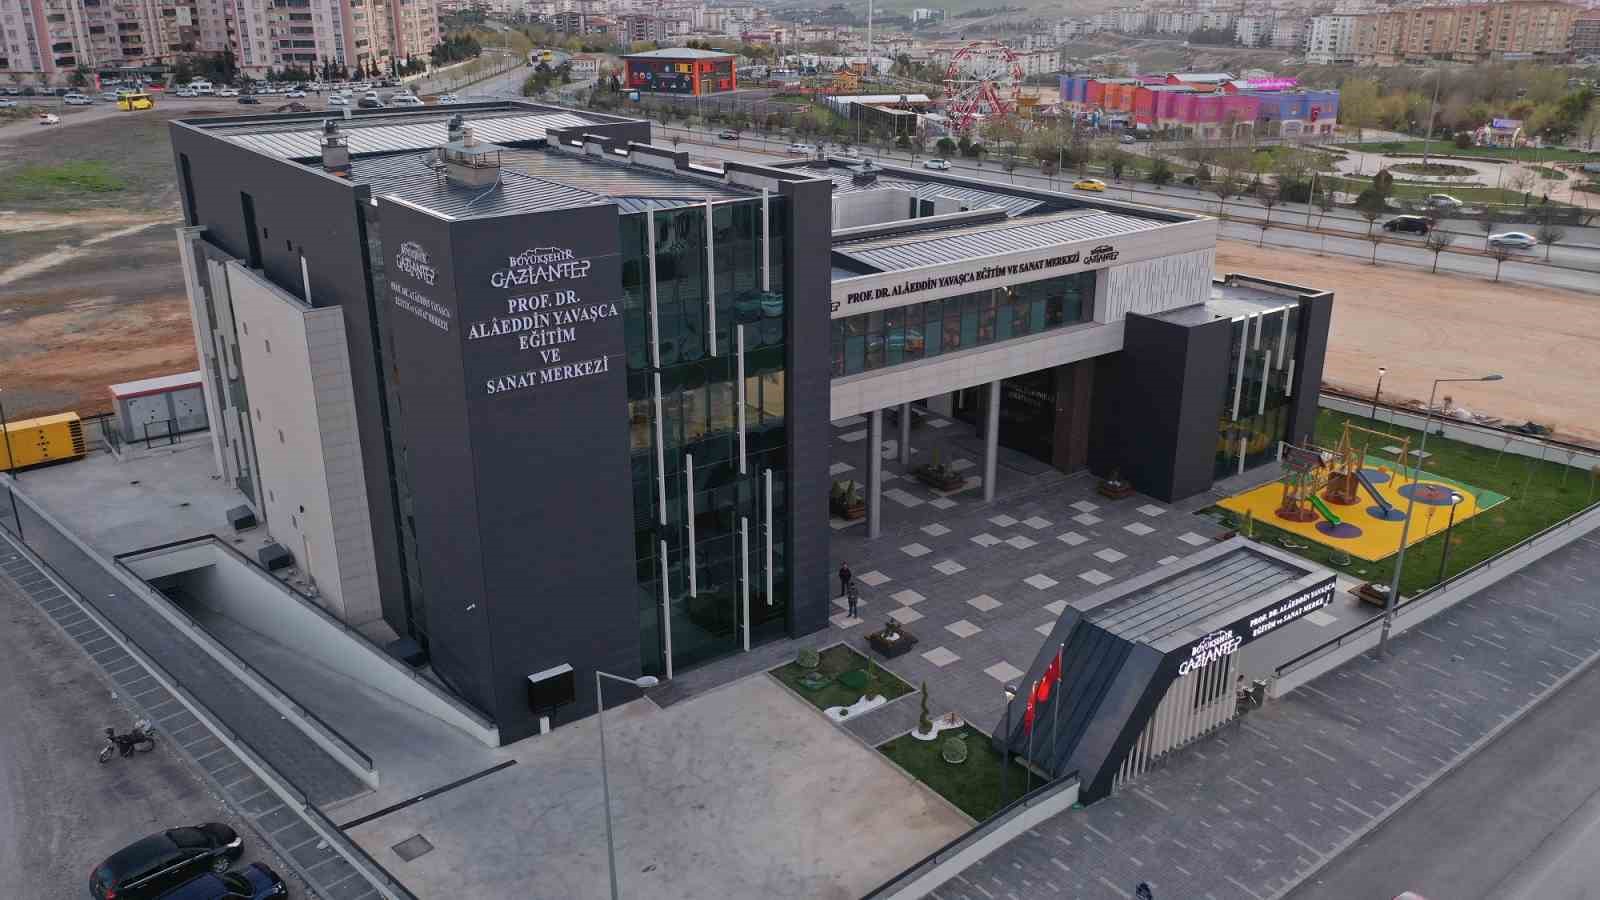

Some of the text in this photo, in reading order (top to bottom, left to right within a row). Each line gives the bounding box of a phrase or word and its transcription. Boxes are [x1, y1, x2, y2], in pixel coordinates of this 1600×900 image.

[507, 289, 581, 314] PROF. DR.
[847, 290, 874, 304] PROF.
[875, 287, 890, 299] DR.
[468, 311, 550, 340] ALÂEDDİN
[553, 303, 619, 325] YAVAŞCA
[519, 326, 576, 350] EĞİTİM
[541, 348, 561, 364] VE
[486, 355, 609, 394] SANAT MERKEZİ
